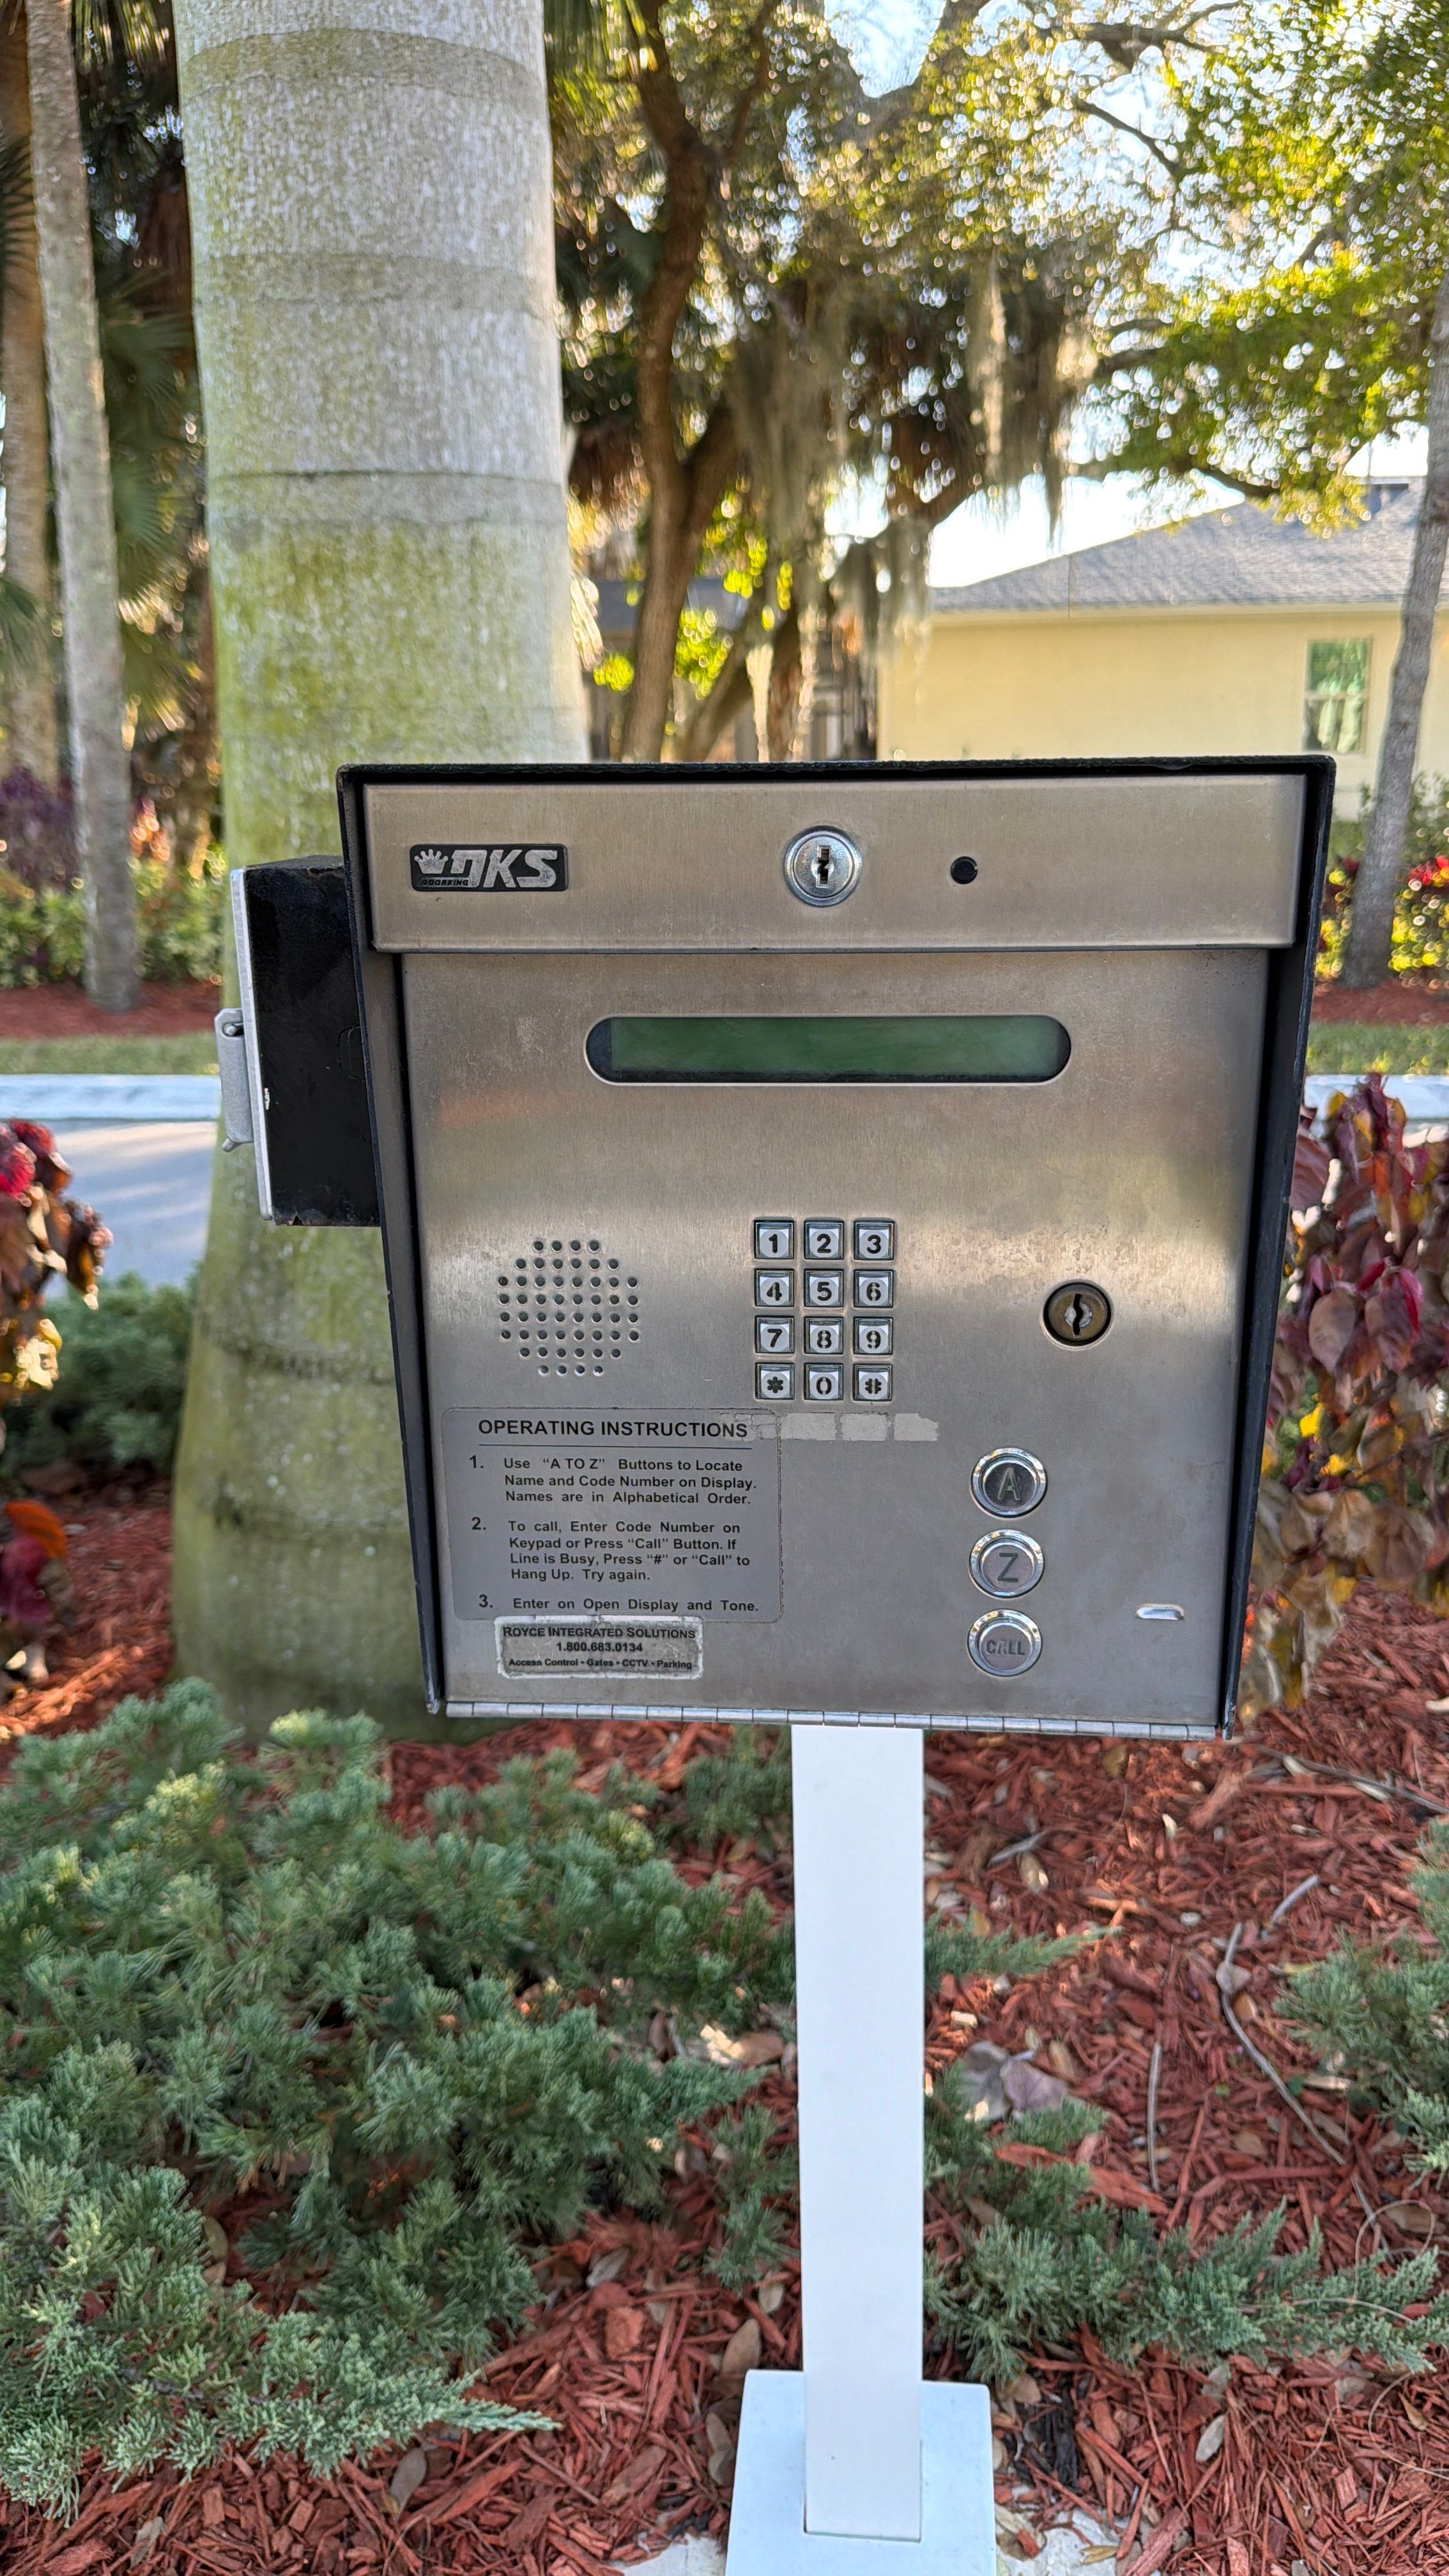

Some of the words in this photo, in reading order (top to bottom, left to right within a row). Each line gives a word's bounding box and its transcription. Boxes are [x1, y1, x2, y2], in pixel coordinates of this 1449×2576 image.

[450, 849, 558, 888] DKS
[769, 1234, 778, 1254] 1
[816, 1233, 831, 1253] 2
[866, 1235, 881, 1254] 3
[767, 1282, 782, 1301] 4
[817, 1282, 831, 1301] 5
[866, 1282, 881, 1301] 6
[767, 1328, 783, 1347] 7
[816, 1330, 831, 1349] 8
[866, 1330, 881, 1349] 9
[816, 1377, 831, 1395] 0
[865, 1378, 882, 1395] #
[479, 1420, 594, 1435] OPERATING
[602, 1421, 747, 1438] INSTRUCTIONS
[470, 1455, 484, 1468] 1.
[504, 1458, 530, 1468] Use
[543, 1459, 560, 1469] “A
[565, 1459, 585, 1469] TO
[590, 1459, 604, 1469] Z”
[618, 1459, 673, 1469] Buttons
[678, 1460, 691, 1470] to
[696, 1460, 742, 1471] Locate
[505, 1475, 544, 1485] Name
[549, 1476, 574, 1485] and
[579, 1476, 615, 1486] Code
[620, 1476, 675, 1487] Number
[679, 1478, 696, 1487] on
[702, 1477, 756, 1491] Display.
[997, 1468, 1021, 1501] A
[506, 1491, 553, 1501] Names
[592, 1492, 604, 1502] in
[613, 1492, 698, 1505] Alphabetical
[708, 1493, 750, 1504] Order.
[472, 1517, 486, 1530] 2.
[508, 1521, 525, 1531] To
[534, 1521, 561, 1533] call,
[571, 1521, 607, 1531] Enter
[616, 1521, 651, 1531] Code
[661, 1522, 714, 1532] Number
[510, 1538, 560, 1551] Keypad
[585, 1538, 623, 1548] Press
[628, 1538, 668, 1549] “Call”
[674, 1538, 723, 1549] Button.
[728, 1539, 736, 1549] If
[510, 1553, 539, 1563] Line
[544, 1554, 555, 1563] is
[560, 1553, 599, 1567] Busy,
[604, 1554, 642, 1564] Press
[647, 1554, 668, 1564] “#”
[692, 1554, 732, 1565] “Call”
[737, 1556, 749, 1565] to
[997, 1552, 1018, 1583] Z
[512, 1568, 546, 1581] Hang
[552, 1569, 573, 1583] Up.
[582, 1569, 604, 1582] Try
[610, 1570, 650, 1582] again.
[479, 1595, 493, 1608] 3.
[514, 1598, 549, 1609] Enter
[583, 1598, 619, 1613] Open
[629, 1599, 679, 1614] Display
[687, 1600, 712, 1610] and
[721, 1600, 758, 1611] Tone.
[503, 1627, 546, 1637] ROYCE
[548, 1627, 624, 1637] INTEGRATED
[626, 1627, 696, 1639] SOLUTIONS
[556, 1642, 643, 1652] 1.800.683.0134
[985, 1639, 1025, 1656] CALL
[586, 1659, 613, 1667] Gates
[622, 1659, 648, 1667] CCTV
[657, 1660, 693, 1669] Parking
